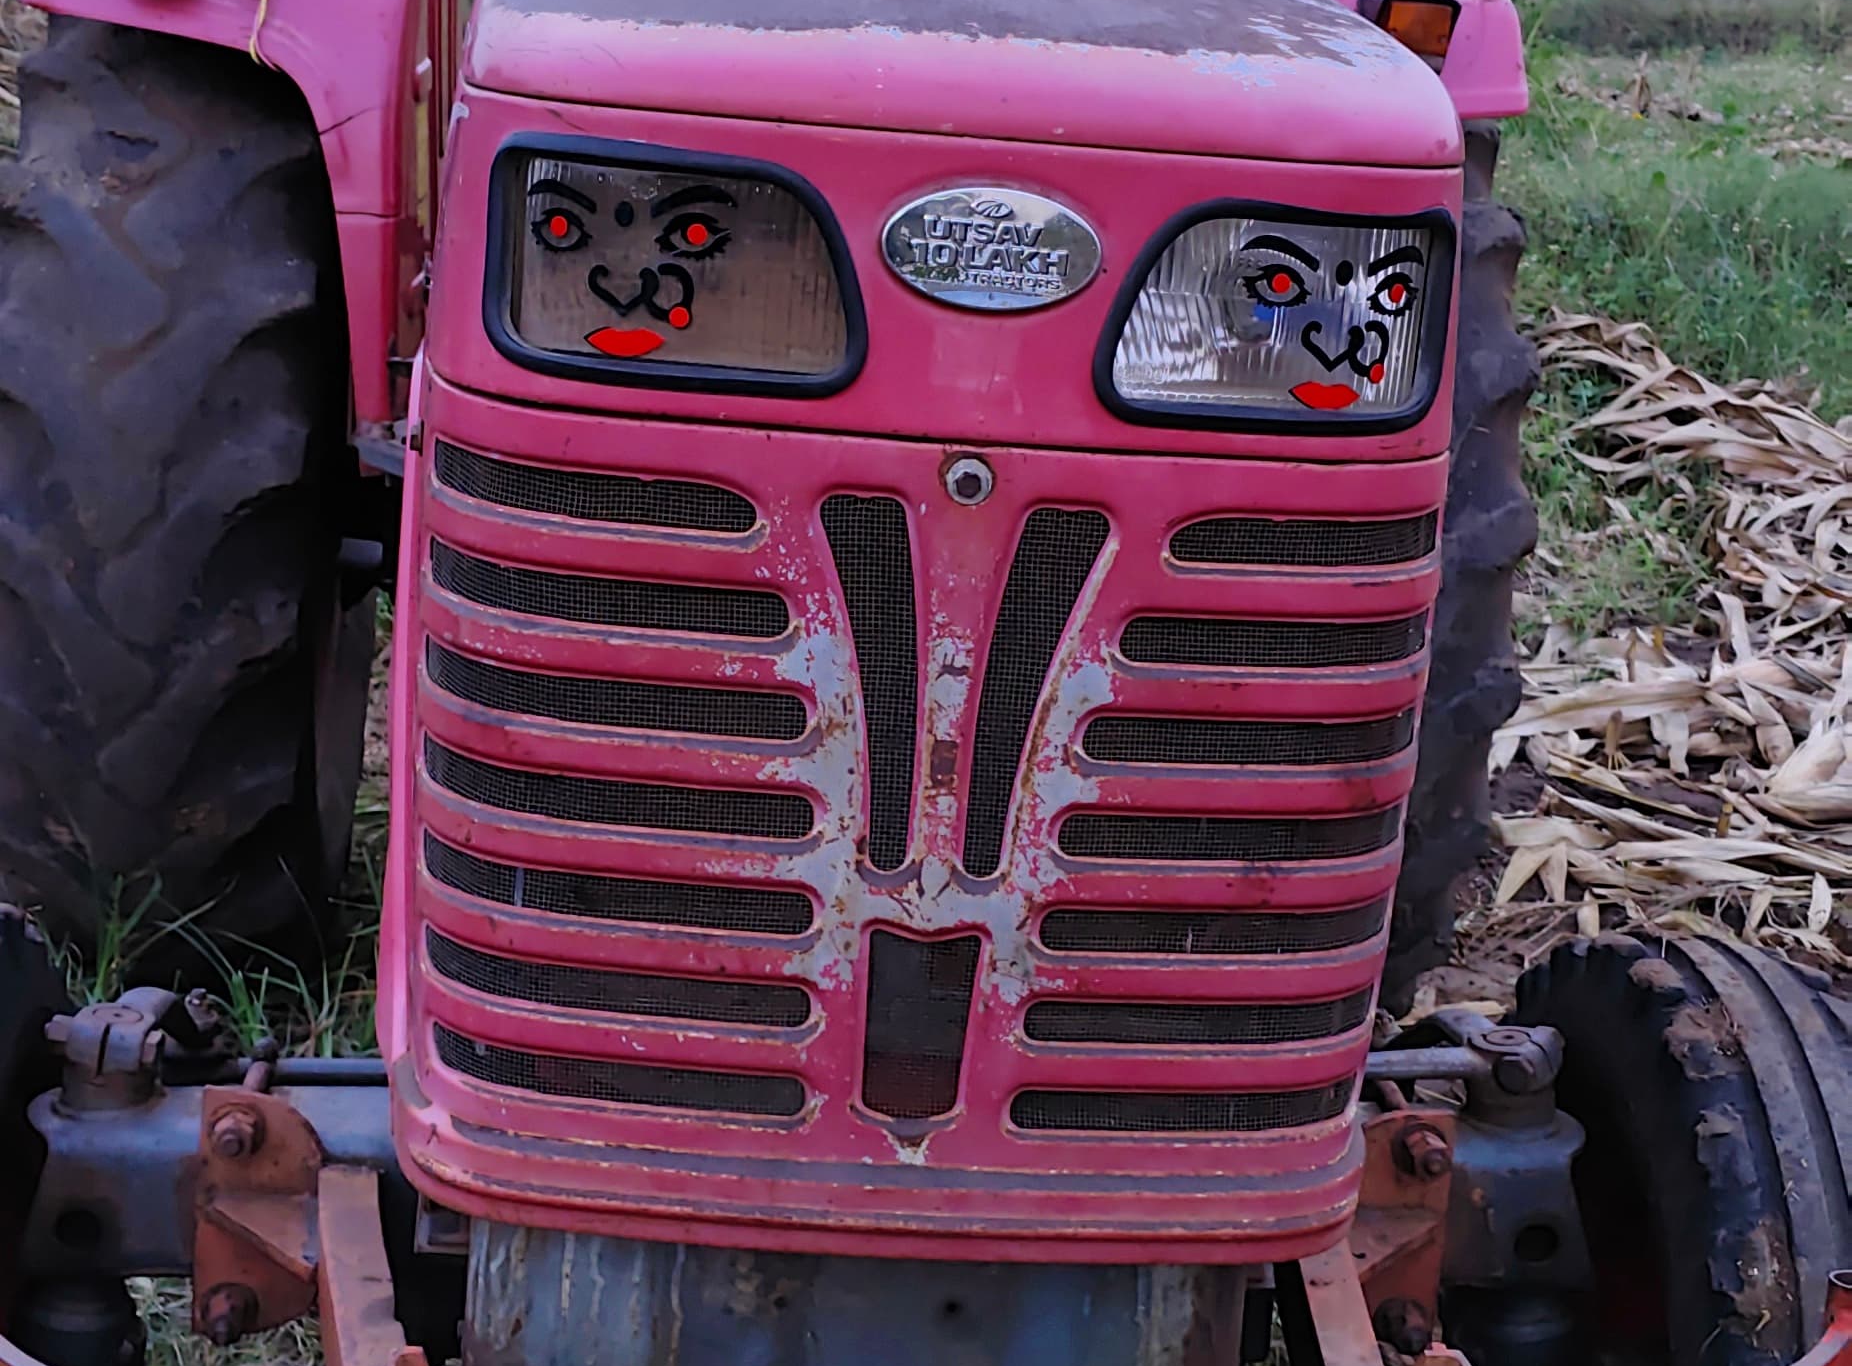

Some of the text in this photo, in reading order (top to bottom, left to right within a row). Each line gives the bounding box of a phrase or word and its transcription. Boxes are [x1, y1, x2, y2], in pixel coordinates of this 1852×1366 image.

[923, 214, 1042, 246] UTSAV
[911, 239, 1069, 276] 10 LAKH
[967, 272, 1062, 291] TRACTORS
